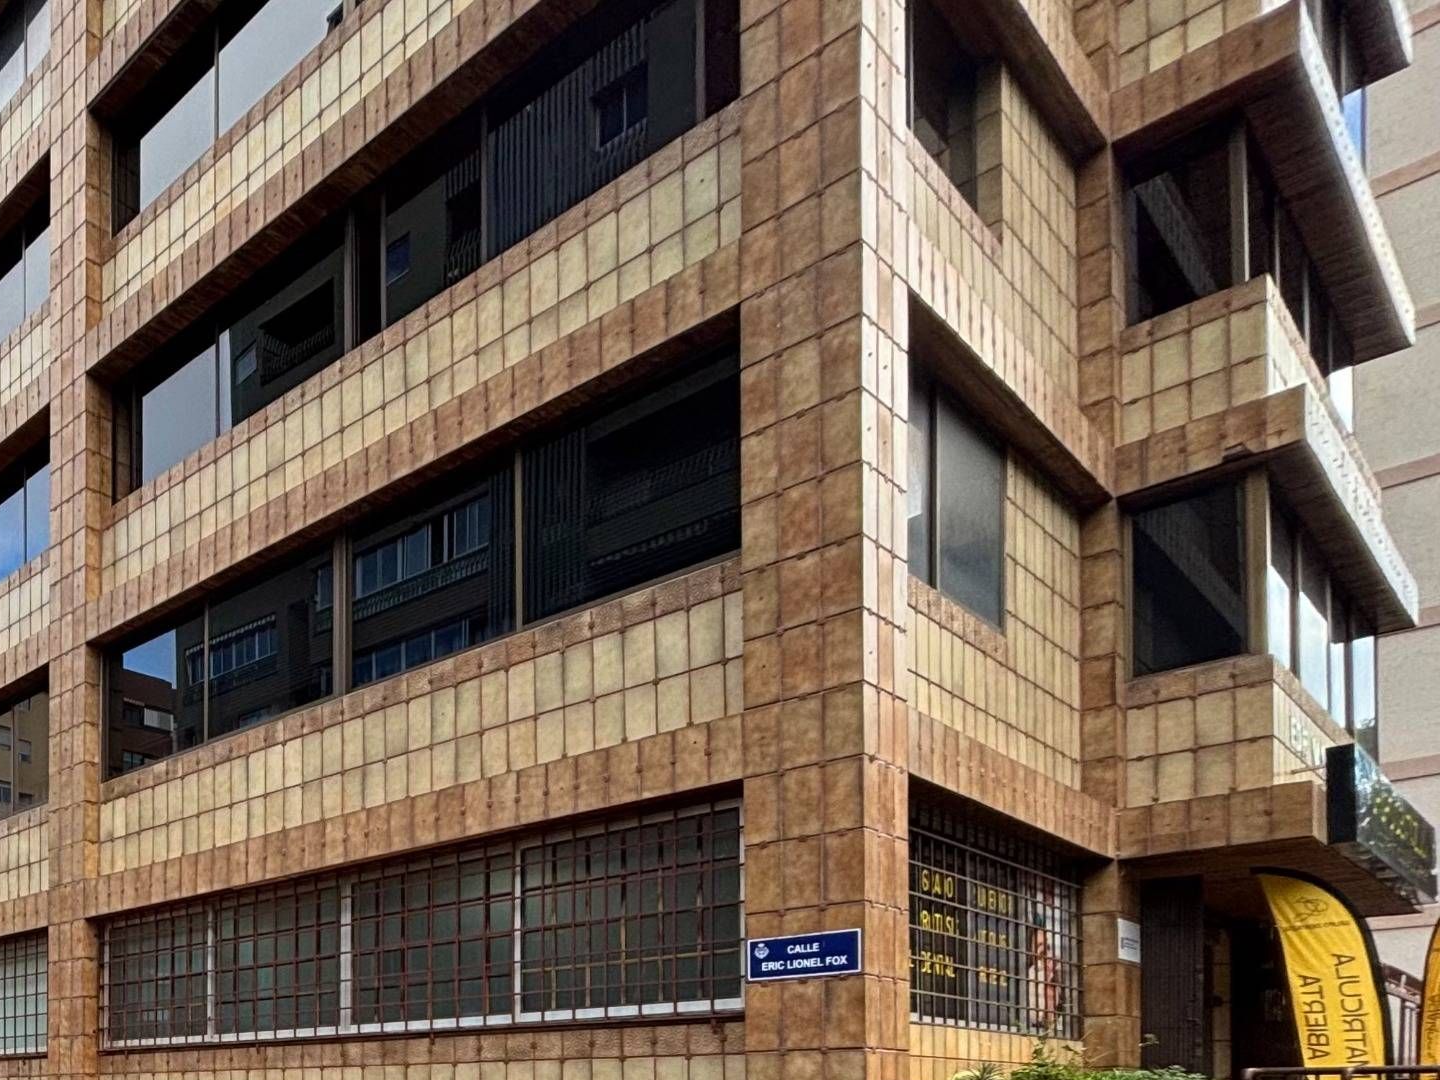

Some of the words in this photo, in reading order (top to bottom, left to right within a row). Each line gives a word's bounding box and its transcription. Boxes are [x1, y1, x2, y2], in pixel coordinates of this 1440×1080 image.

[787, 943, 820, 954] CALLE
[762, 961, 785, 972] ERIC
[787, 957, 824, 969] LIONEL
[826, 955, 848, 966] FOX
